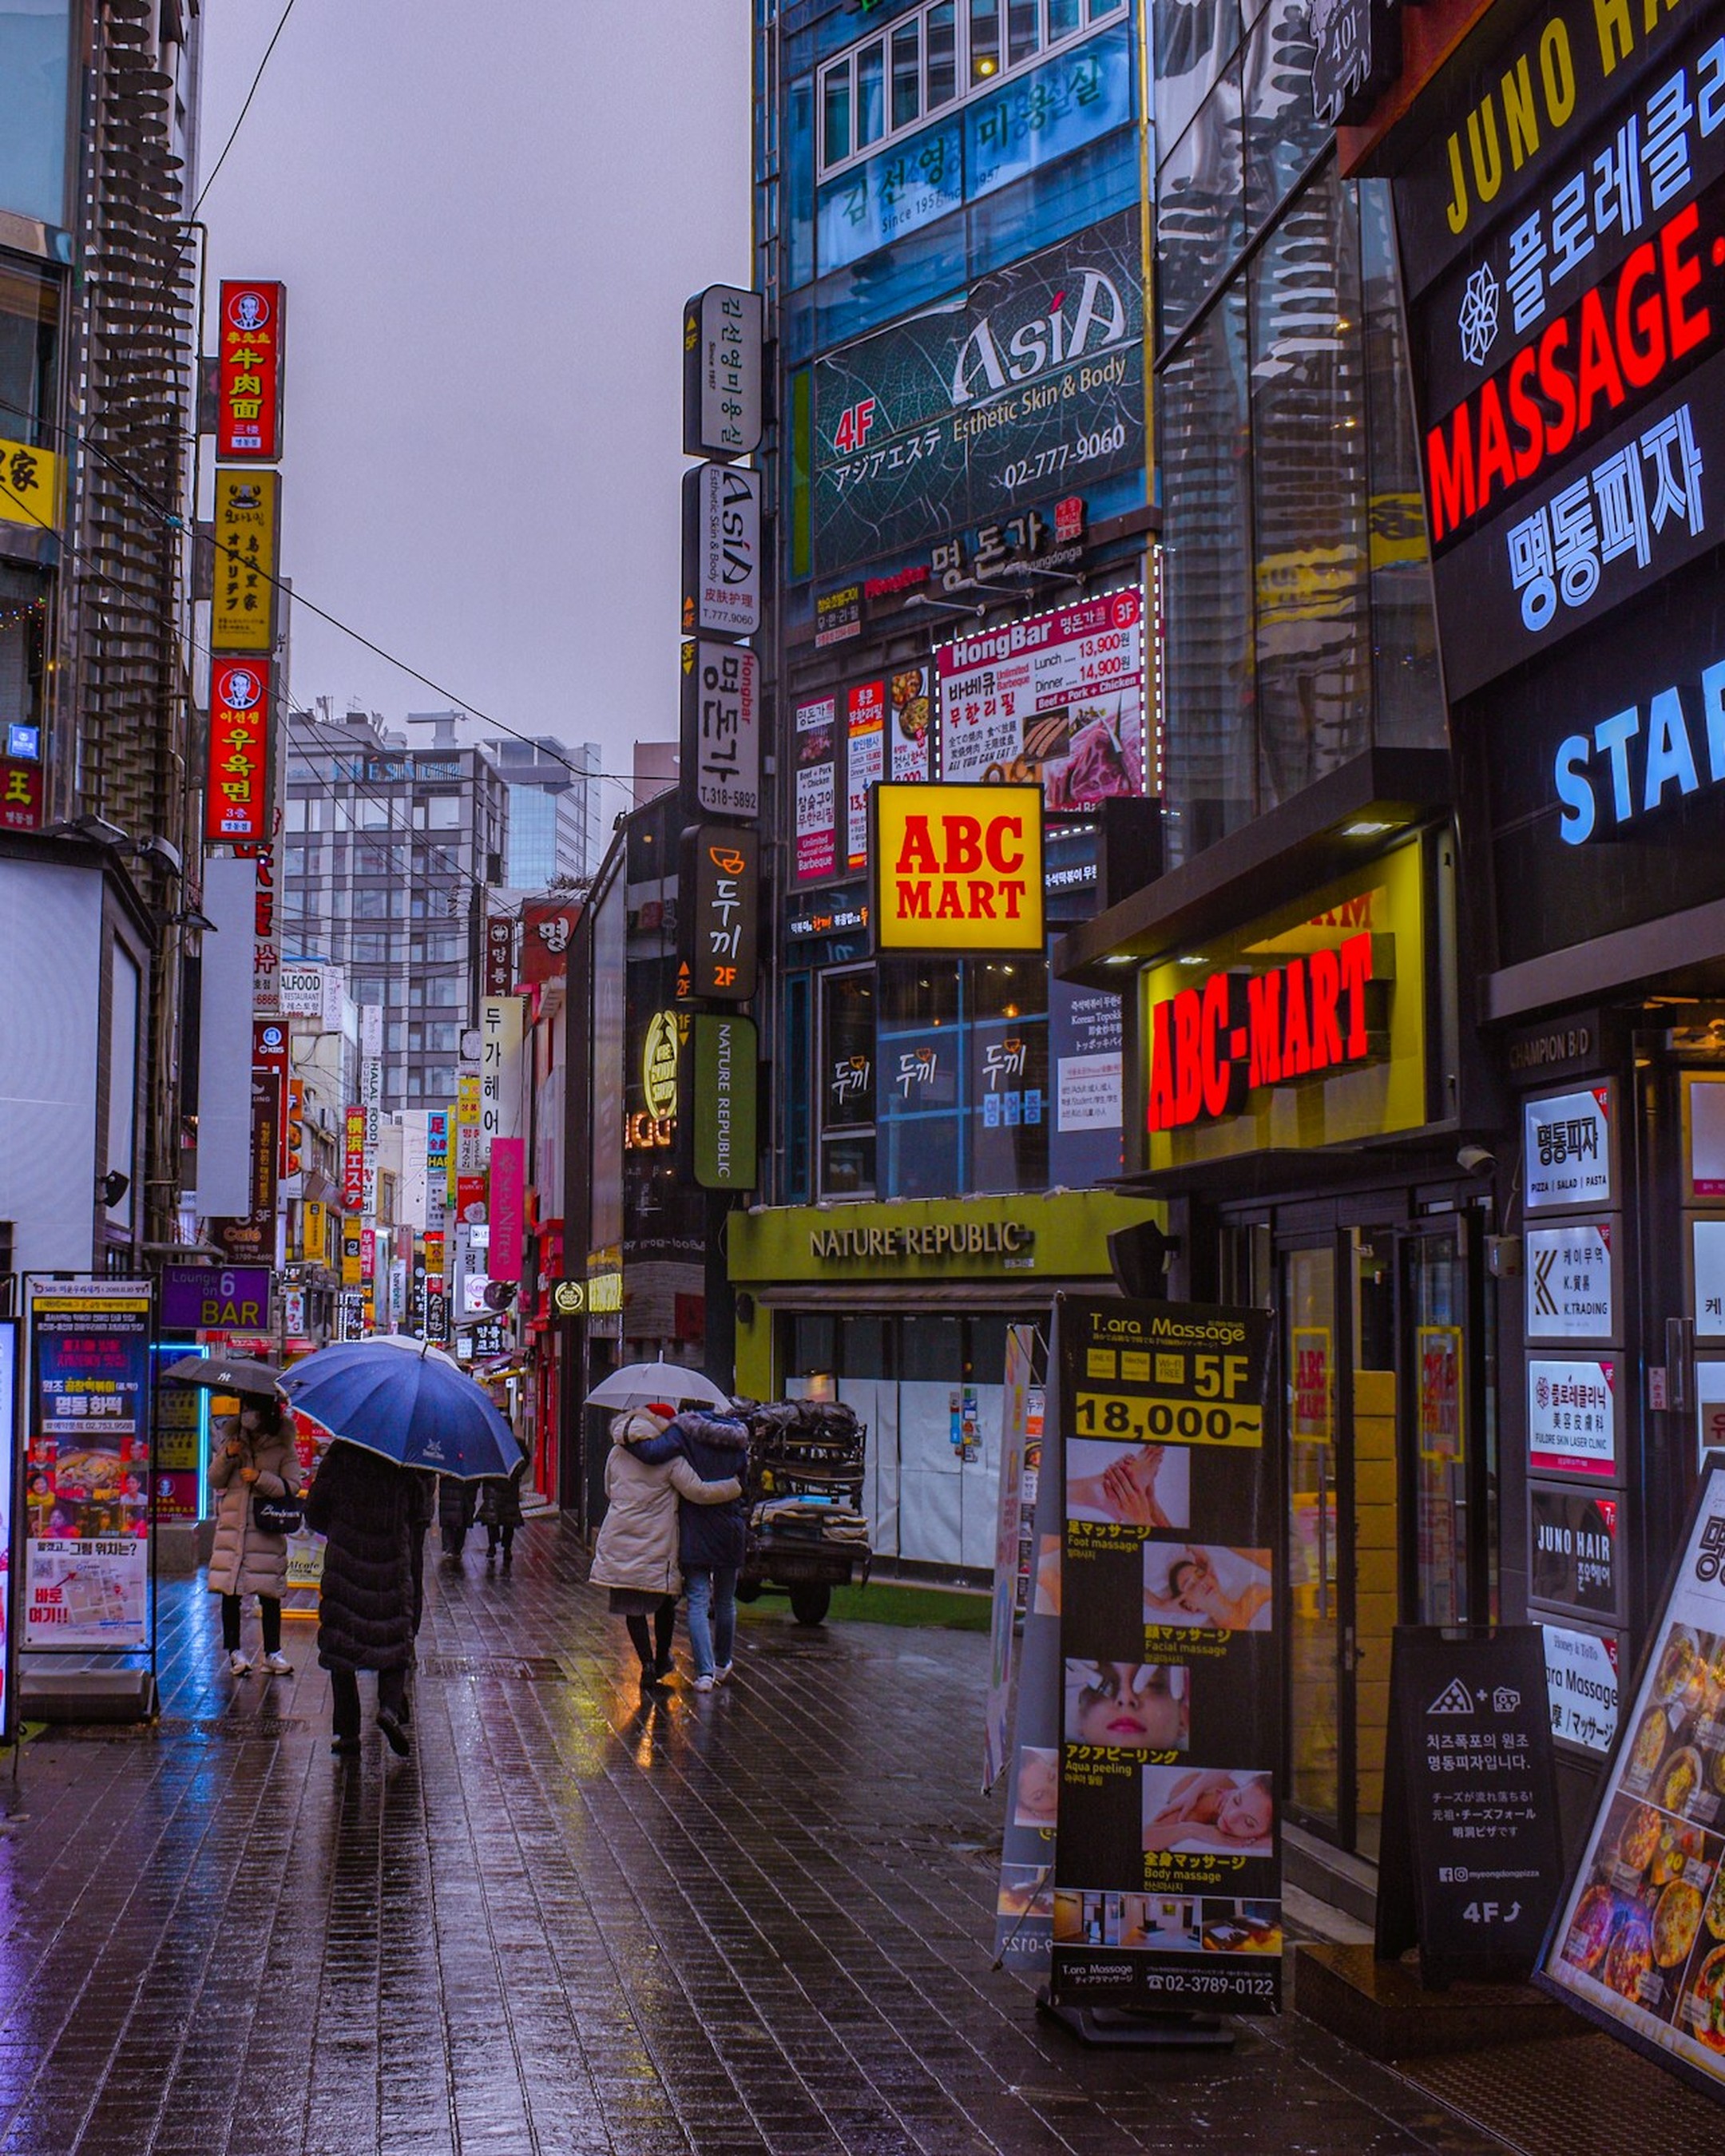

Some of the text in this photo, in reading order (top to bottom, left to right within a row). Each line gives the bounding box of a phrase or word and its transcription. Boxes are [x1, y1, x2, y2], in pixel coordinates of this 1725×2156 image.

[1447, 18, 1576, 234] JUNO
[843, 54, 1100, 227] 김선영 미용실
[882, 207, 912, 233] Since
[685, 335, 698, 351] 5F
[229, 347, 264, 419] 牛肉面
[721, 295, 744, 447] 김선영미용실
[1427, 201, 1711, 544] MASSAGE
[954, 358, 1126, 442] Esthetic Skin & Body
[834, 397, 875, 454] 4F
[835, 428, 942, 492] アジアエステ
[1005, 423, 1126, 489] 02-777-9060
[709, 468, 720, 509] Esthetic
[710, 510, 720, 533] Skin
[1506, 403, 1704, 631] 명동피자
[932, 510, 1041, 592] 명돈가
[711, 548, 720, 585] Body
[704, 587, 755, 608] 皮肤护理
[702, 608, 755, 626] T.777.9060
[1060, 609, 1093, 635] 명돈가
[1116, 600, 1133, 623] 3F
[680, 642, 695, 662] 3F
[953, 621, 1053, 669] HongBar
[1034, 652, 1061, 671] Lunch
[740, 653, 755, 725] Hongbar
[949, 672, 996, 701] 바베큐
[1035, 676, 1064, 694] Dinner
[1038, 676, 1136, 710] Beef Pork Chicken
[220, 711, 260, 724] 이선생
[702, 656, 741, 785] 명돈가
[799, 706, 825, 726] 명돈가
[220, 728, 256, 803] 우육면
[799, 766, 832, 781] Beef Pork
[807, 777, 830, 789] Chicken
[700, 786, 758, 811] T.318-5892
[798, 808, 835, 829] 무한리필
[895, 815, 1024, 874] ABC
[799, 856, 832, 871] Barbeque
[896, 881, 1025, 919] MART
[709, 878, 743, 959] 두끼
[713, 965, 736, 988] 2F
[677, 1013, 691, 1032] 1F
[1071, 1015, 1095, 1025] Korean
[1148, 932, 1373, 1132] ABC-MART
[1509, 1032, 1564, 1068] CHAMPION
[483, 1008, 502, 1135] 두가헤어
[895, 1052, 938, 1099] 두끼
[981, 1042, 1027, 1091] 두끼
[831, 1059, 870, 1105] 두끼
[717, 1024, 732, 1179] NATURE REPUBLIC
[1537, 1116, 1598, 1167] 명동피자
[1531, 1174, 1607, 1193] PIZZA SALAD PASTA
[256, 1209, 272, 1223] 3F
[810, 1221, 1021, 1258] NATURE REPUBLIC
[1563, 1246, 1604, 1266] 케이무역
[203, 1286, 218, 1296] on
[220, 1272, 236, 1297] 6
[201, 1301, 260, 1325] BAR
[1564, 1302, 1608, 1315] K.TRADING
[1090, 1313, 1141, 1334] T.ara
[1152, 1318, 1246, 1346] Massage
[1195, 1354, 1249, 1398] 5F
[56, 1397, 88, 1417] 명동
[1551, 1383, 1606, 1410] 플로레클리닉
[1556, 1434, 1607, 1450] SKIN LASER CLINIC
[1067, 1536, 1140, 1553] Foot massage
[1537, 1525, 1611, 1563] JUNO HAIR
[34, 1587, 63, 1604] 바로
[1144, 1640, 1227, 1658] Facial massage
[1565, 1669, 1618, 1708] Massage
[1426, 1733, 1529, 1750] 치즈폭포의 원조
[1065, 1759, 1132, 1778] Aqua peeling
[1428, 1755, 1531, 1773] 명동피자입니다.
[1144, 1852, 1247, 1871] 全身マッサージ
[1144, 1867, 1222, 1884] Body massage
[1462, 1901, 1499, 1924] 4F
[1062, 1964, 1087, 1976] T.ara
[1089, 1963, 1133, 1977] Massage
[1164, 1975, 1275, 1995] 02-3789-0122
